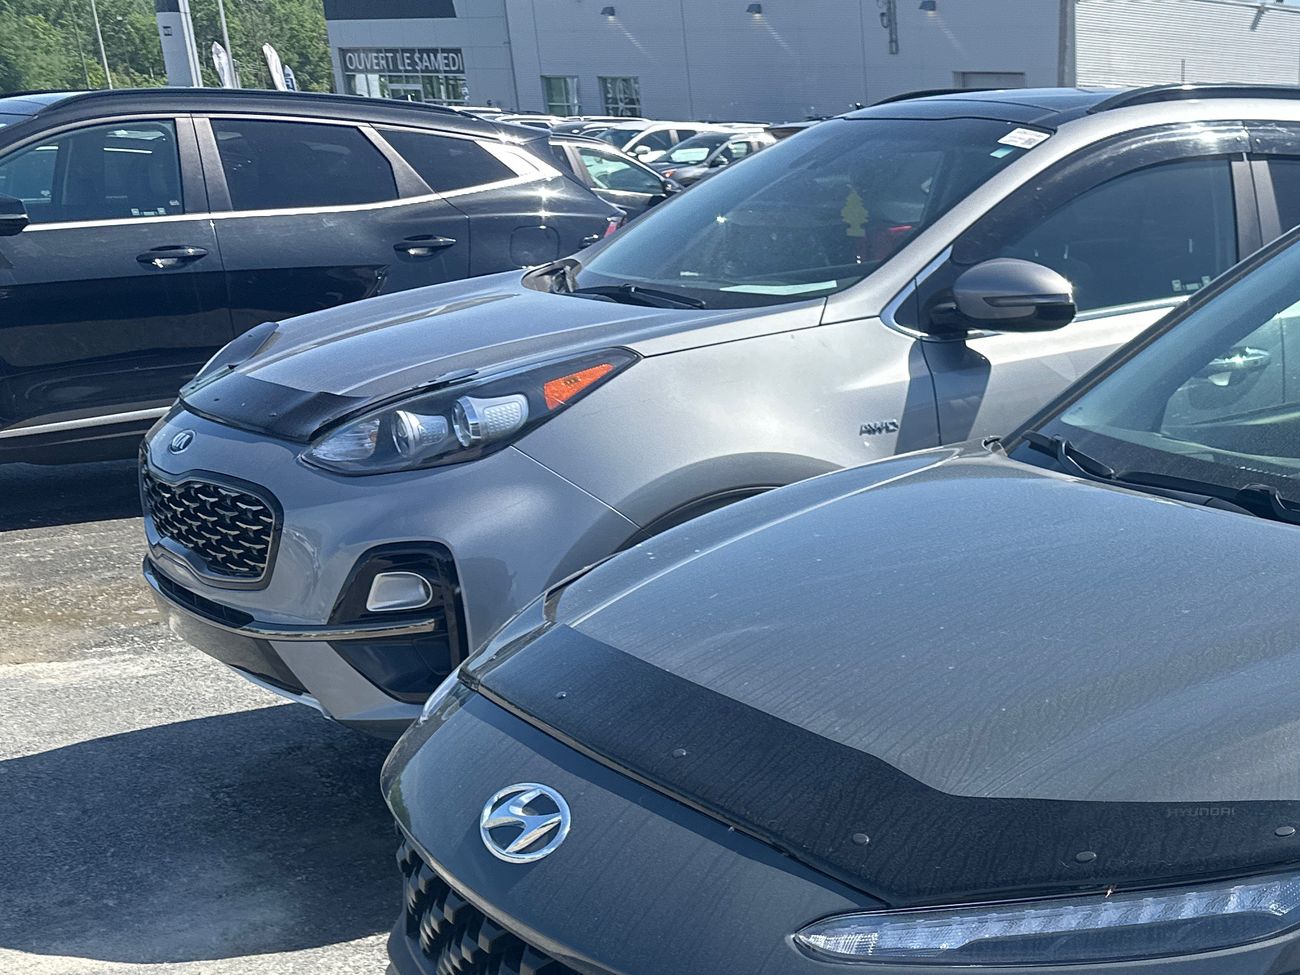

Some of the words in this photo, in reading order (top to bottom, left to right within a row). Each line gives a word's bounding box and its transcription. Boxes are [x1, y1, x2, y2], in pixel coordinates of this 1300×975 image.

[345, 52, 394, 70] OUVERT
[396, 53, 413, 70] LE
[415, 53, 463, 71] SAMEDI
